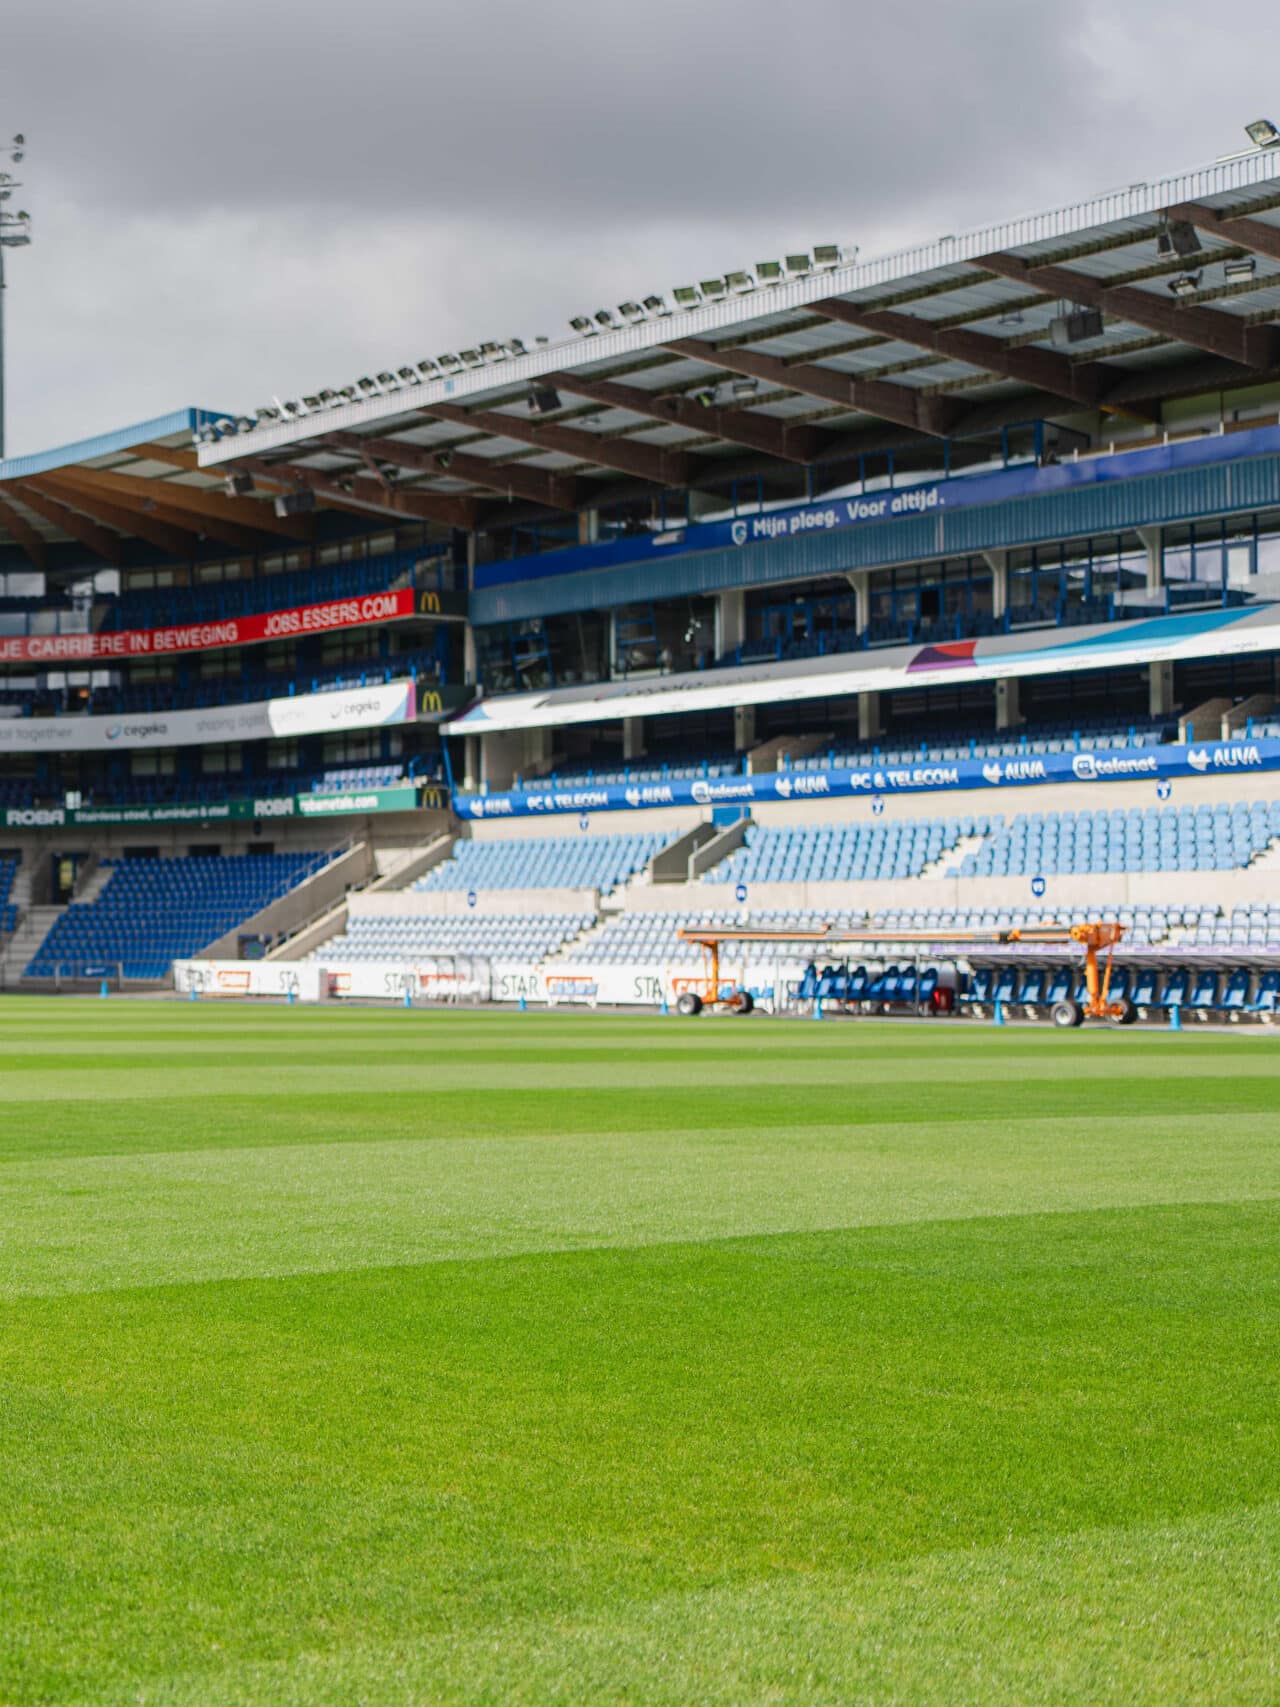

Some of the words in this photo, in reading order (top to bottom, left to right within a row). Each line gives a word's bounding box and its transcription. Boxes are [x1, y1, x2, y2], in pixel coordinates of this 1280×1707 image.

[753, 518, 787, 538] Mijn
[790, 509, 840, 533] ploeg.
[847, 500, 887, 520] Voor
[891, 487, 945, 513] altijd.
[264, 595, 398, 635] JOBS.ESSERS.COM
[130, 632, 149, 651] IN
[154, 622, 238, 649] BEWEGING
[344, 700, 380, 716] cegeka
[124, 723, 167, 738] cegeka
[1095, 756, 1158, 774] telenet
[850, 773, 872, 789] PC
[887, 768, 959, 787] TELECOM
[554, 792, 608, 808] TELECOM
[7, 809, 65, 826] ROBA
